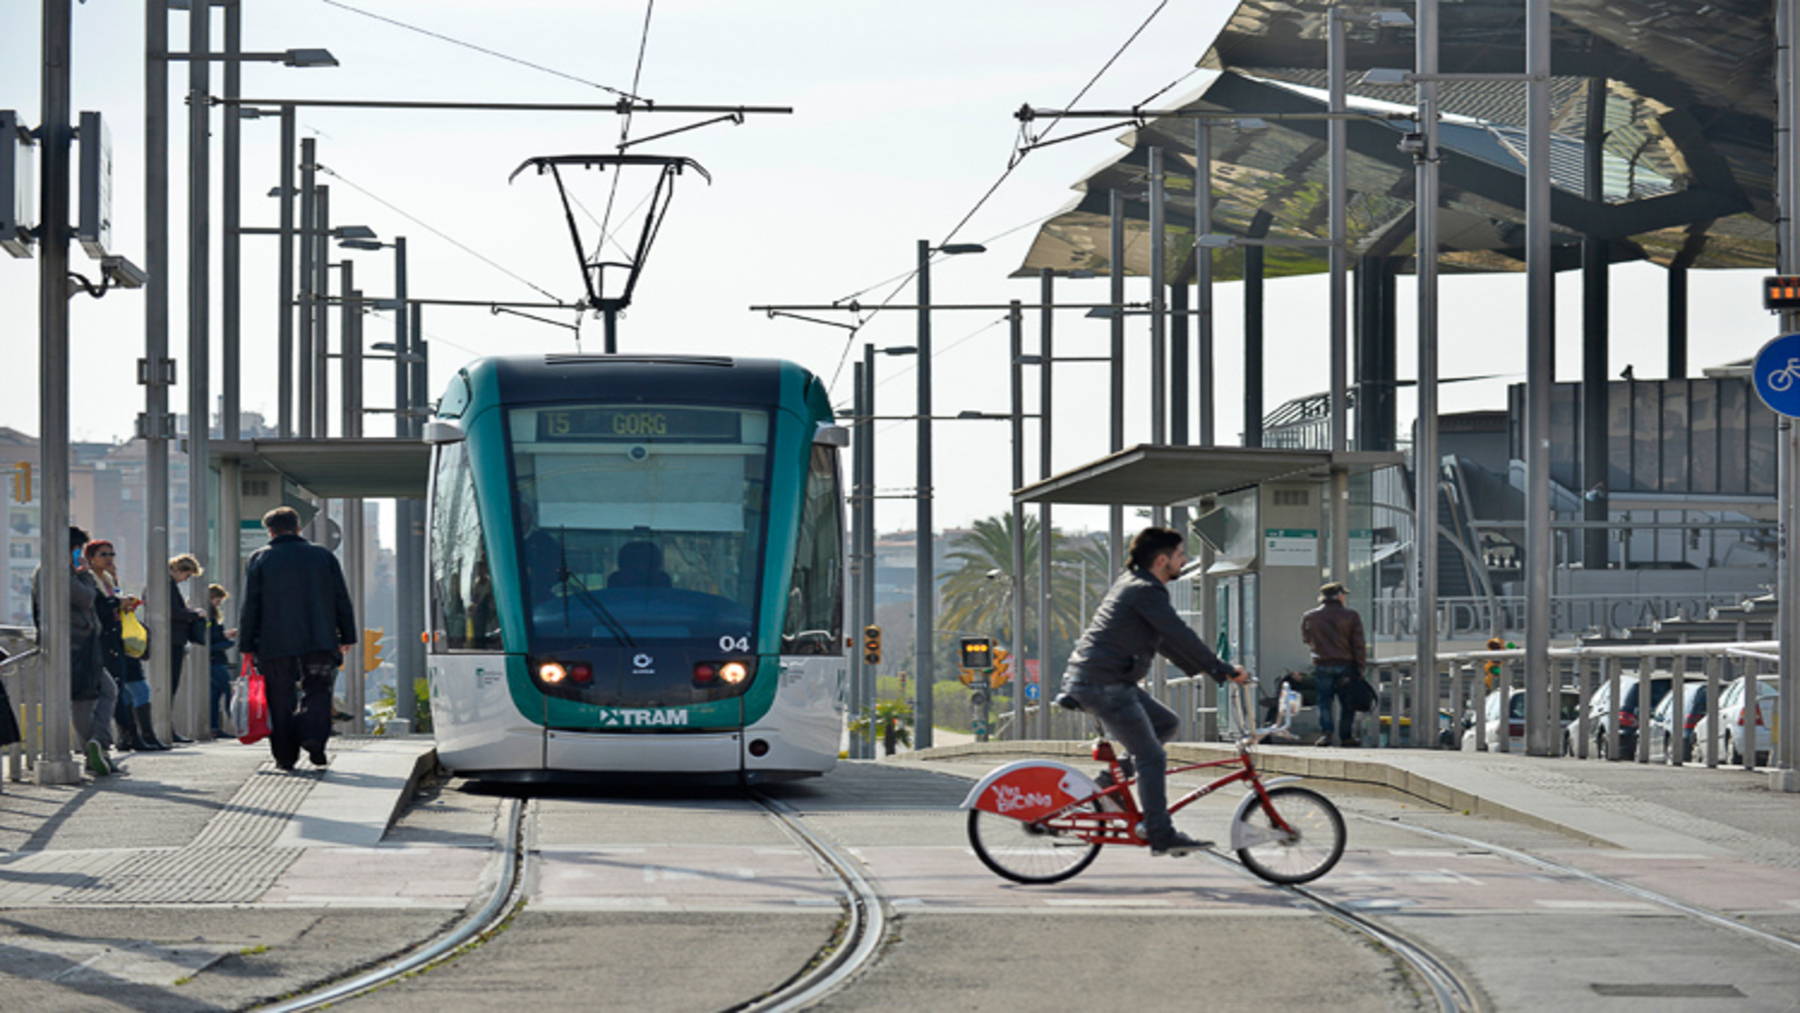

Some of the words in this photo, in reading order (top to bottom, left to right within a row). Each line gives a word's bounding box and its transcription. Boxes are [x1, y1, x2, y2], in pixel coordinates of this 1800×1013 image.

[546, 413, 570, 433] T5
[613, 413, 667, 434] GORG
[719, 635, 750, 652] 04
